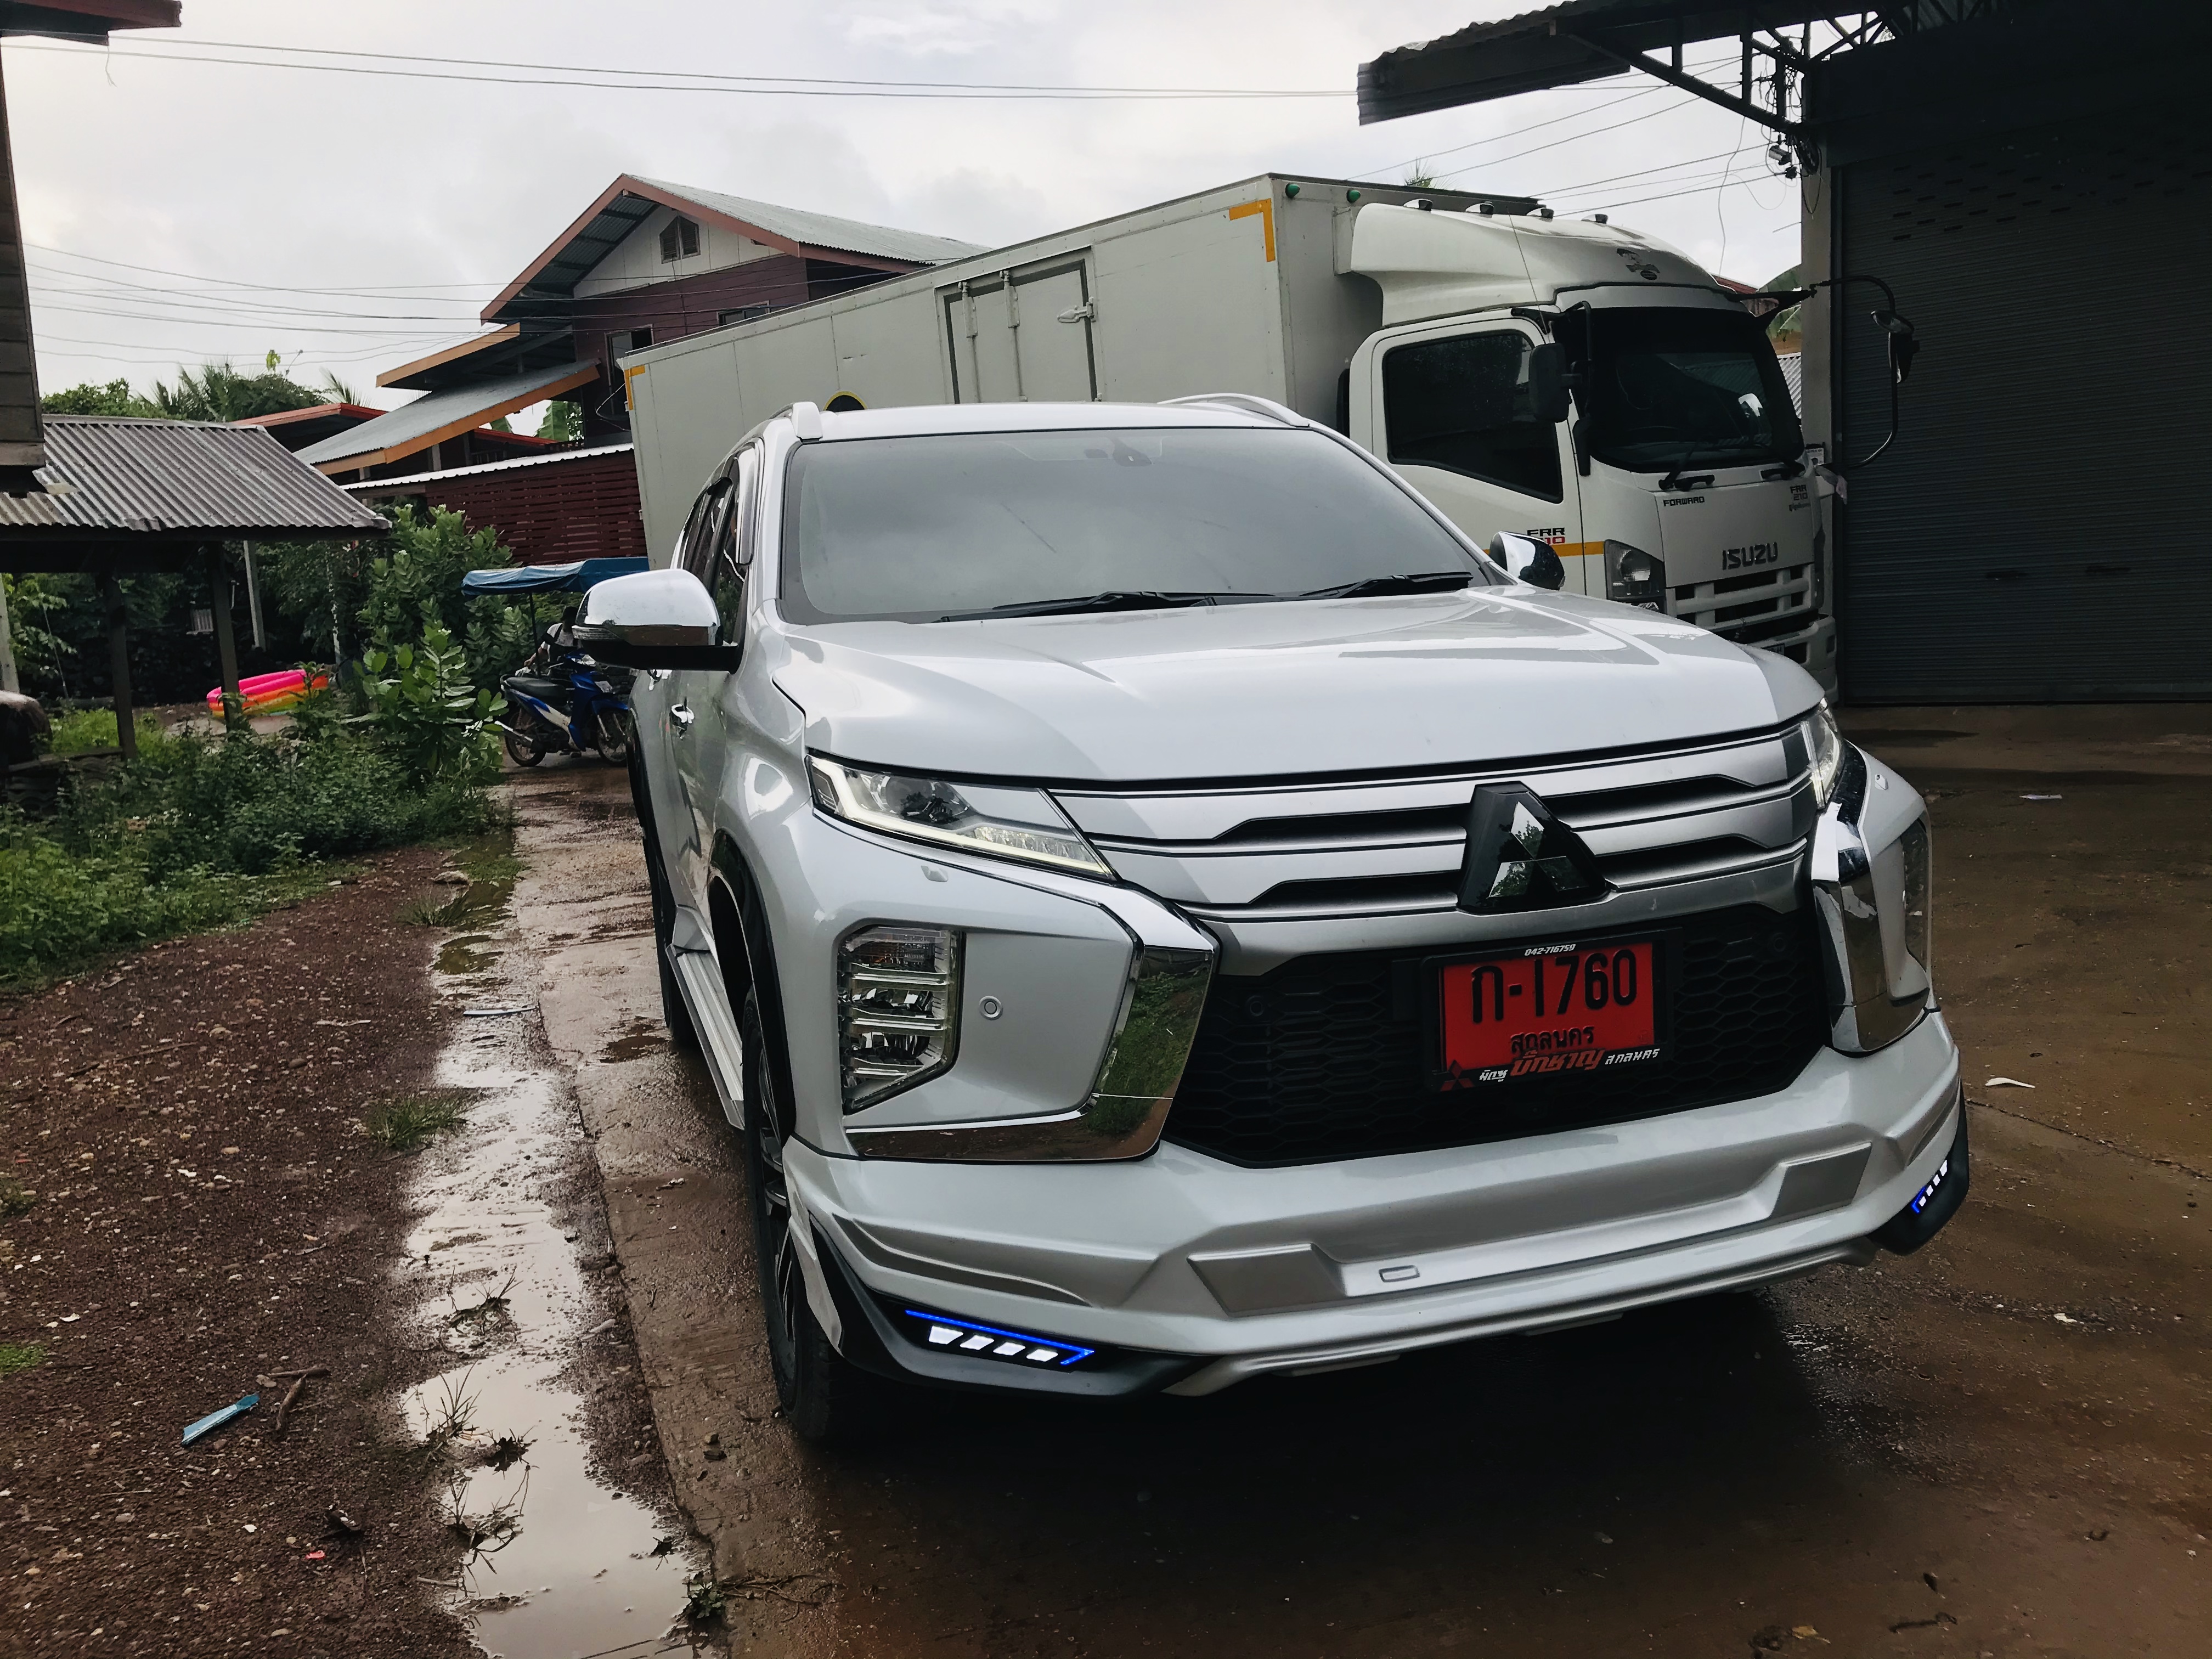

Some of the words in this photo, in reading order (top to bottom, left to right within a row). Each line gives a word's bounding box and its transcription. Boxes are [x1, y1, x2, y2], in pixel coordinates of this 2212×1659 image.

[1790, 484, 1807, 494] FRR
[1663, 496, 1705, 507] FORWARD
[1793, 493, 1808, 501] 210
[1527, 527, 1565, 537] FRR
[1539, 536, 1565, 545] 10
[1722, 541, 1779, 571] ISUZU
[1524, 944, 1576, 956] 042-716759
[1471, 949, 1638, 1024] ก-1760
[1510, 1025, 1595, 1054] สกลนคร
[1604, 1048, 1661, 1065] สกลนคร
